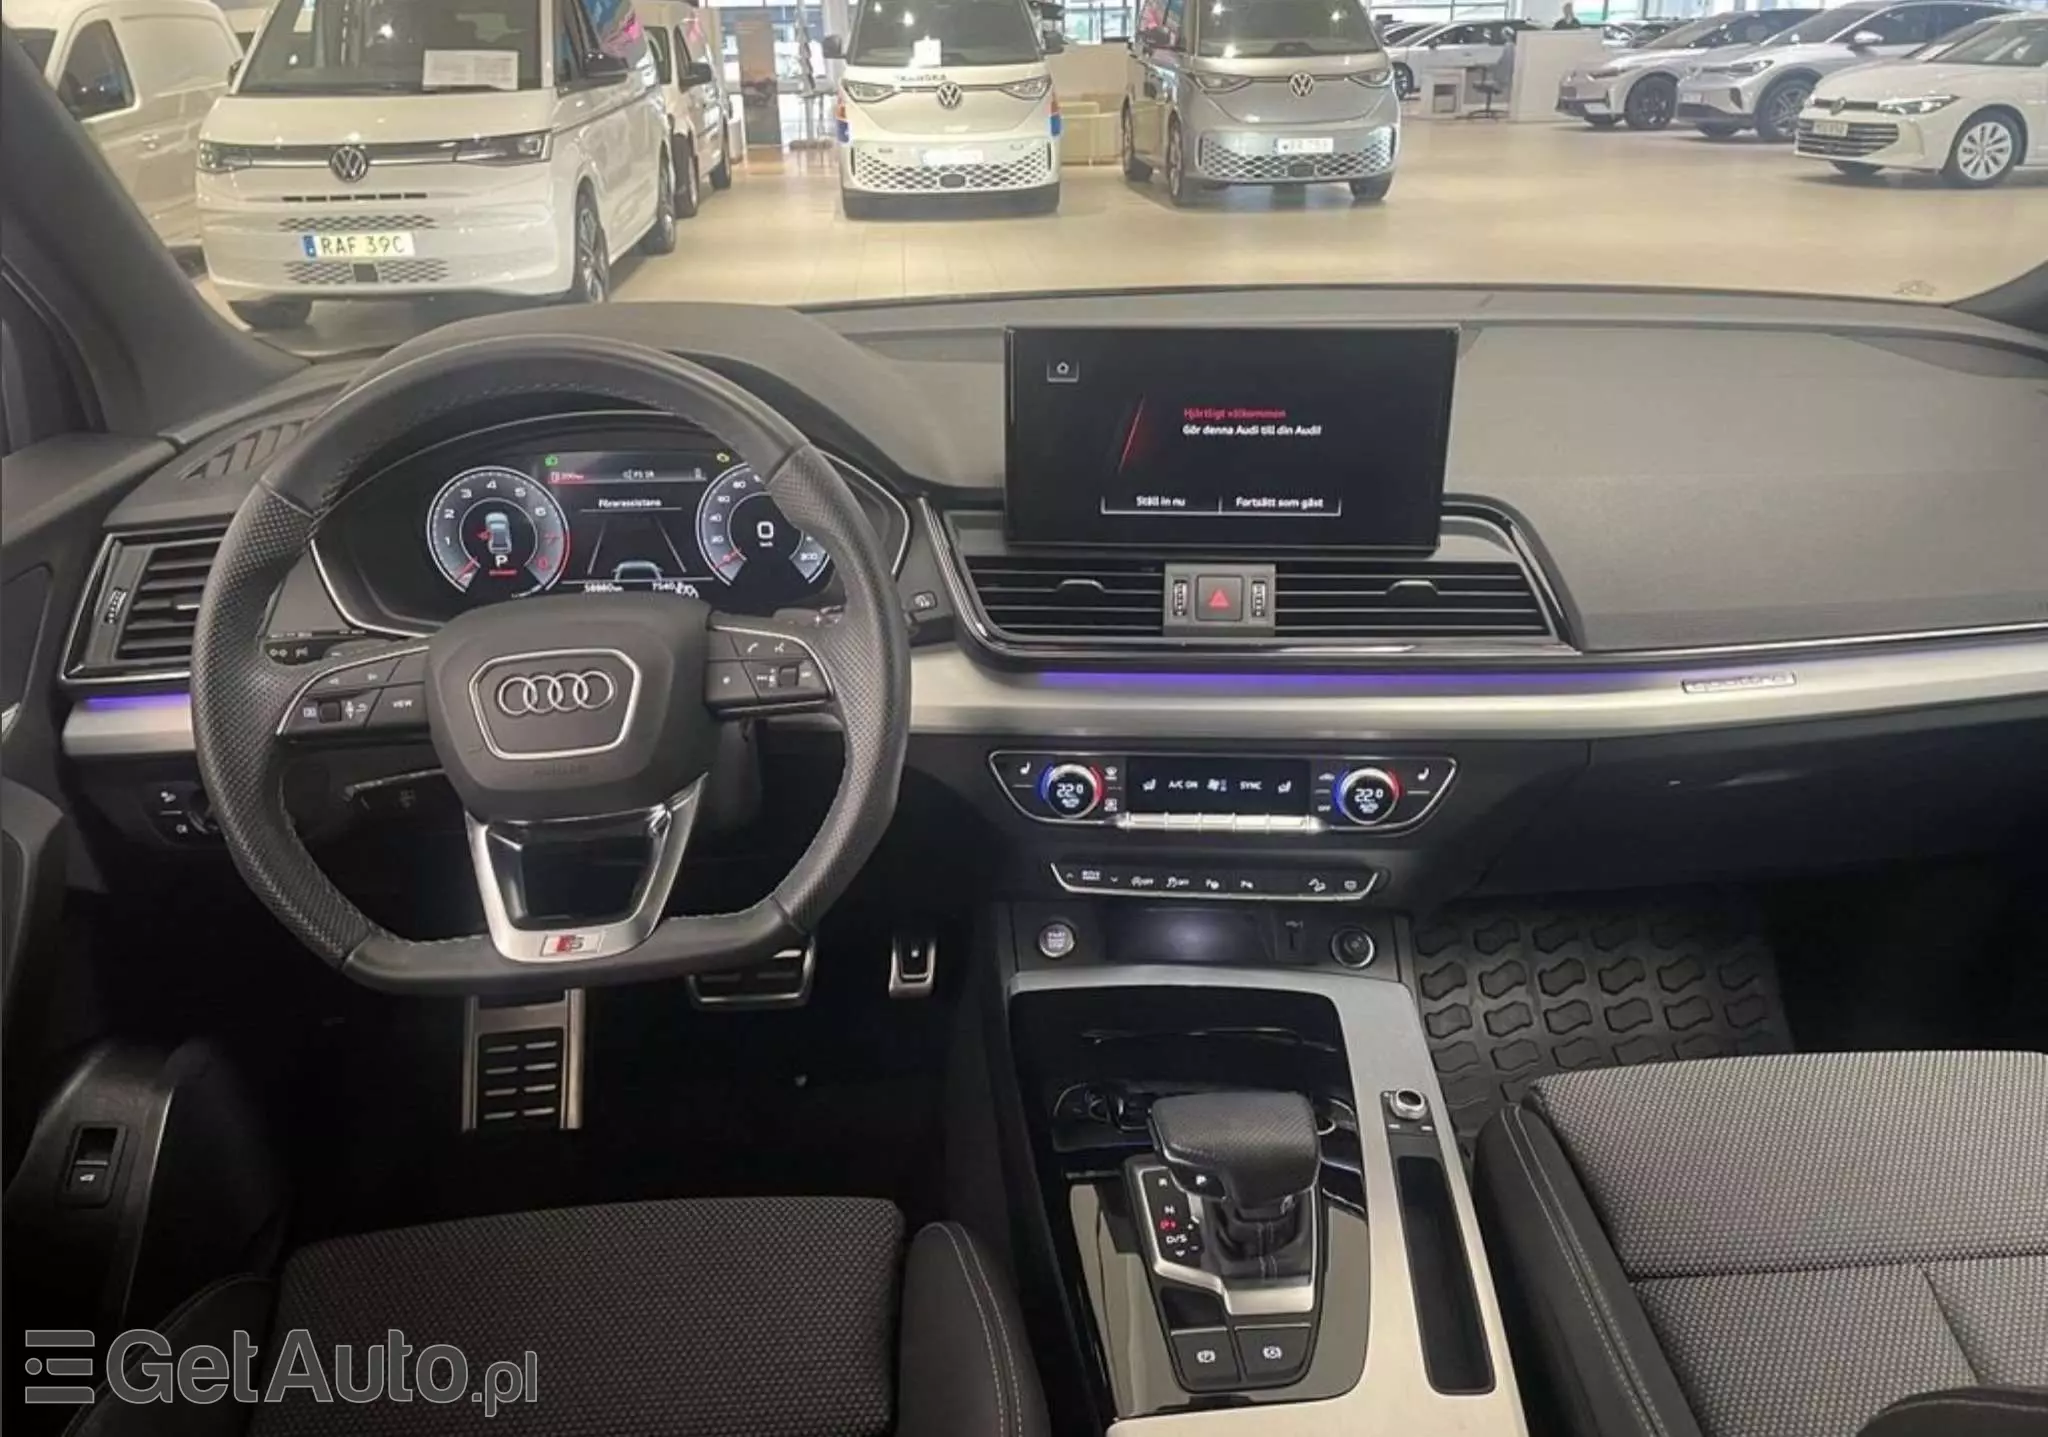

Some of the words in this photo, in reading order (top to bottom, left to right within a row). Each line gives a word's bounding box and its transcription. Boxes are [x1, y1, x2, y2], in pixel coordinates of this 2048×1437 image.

[320, 237, 356, 254] RAF
[366, 235, 405, 253] 39C
[1182, 425, 1201, 435] Gör
[1202, 425, 1234, 435] denna
[1235, 425, 1259, 435] Audi
[1261, 425, 1275, 435] till
[1276, 425, 1293, 435] din
[486, 480, 498, 489] 4
[460, 488, 472, 499] 3
[1172, 498, 1186, 507] nu
[1278, 499, 1299, 508] som
[444, 508, 456, 519] 2
[757, 521, 774, 539] 0
[495, 555, 508, 566] P
[1240, 780, 1262, 790] SYNC
[1166, 1234, 1187, 1244] D/S
